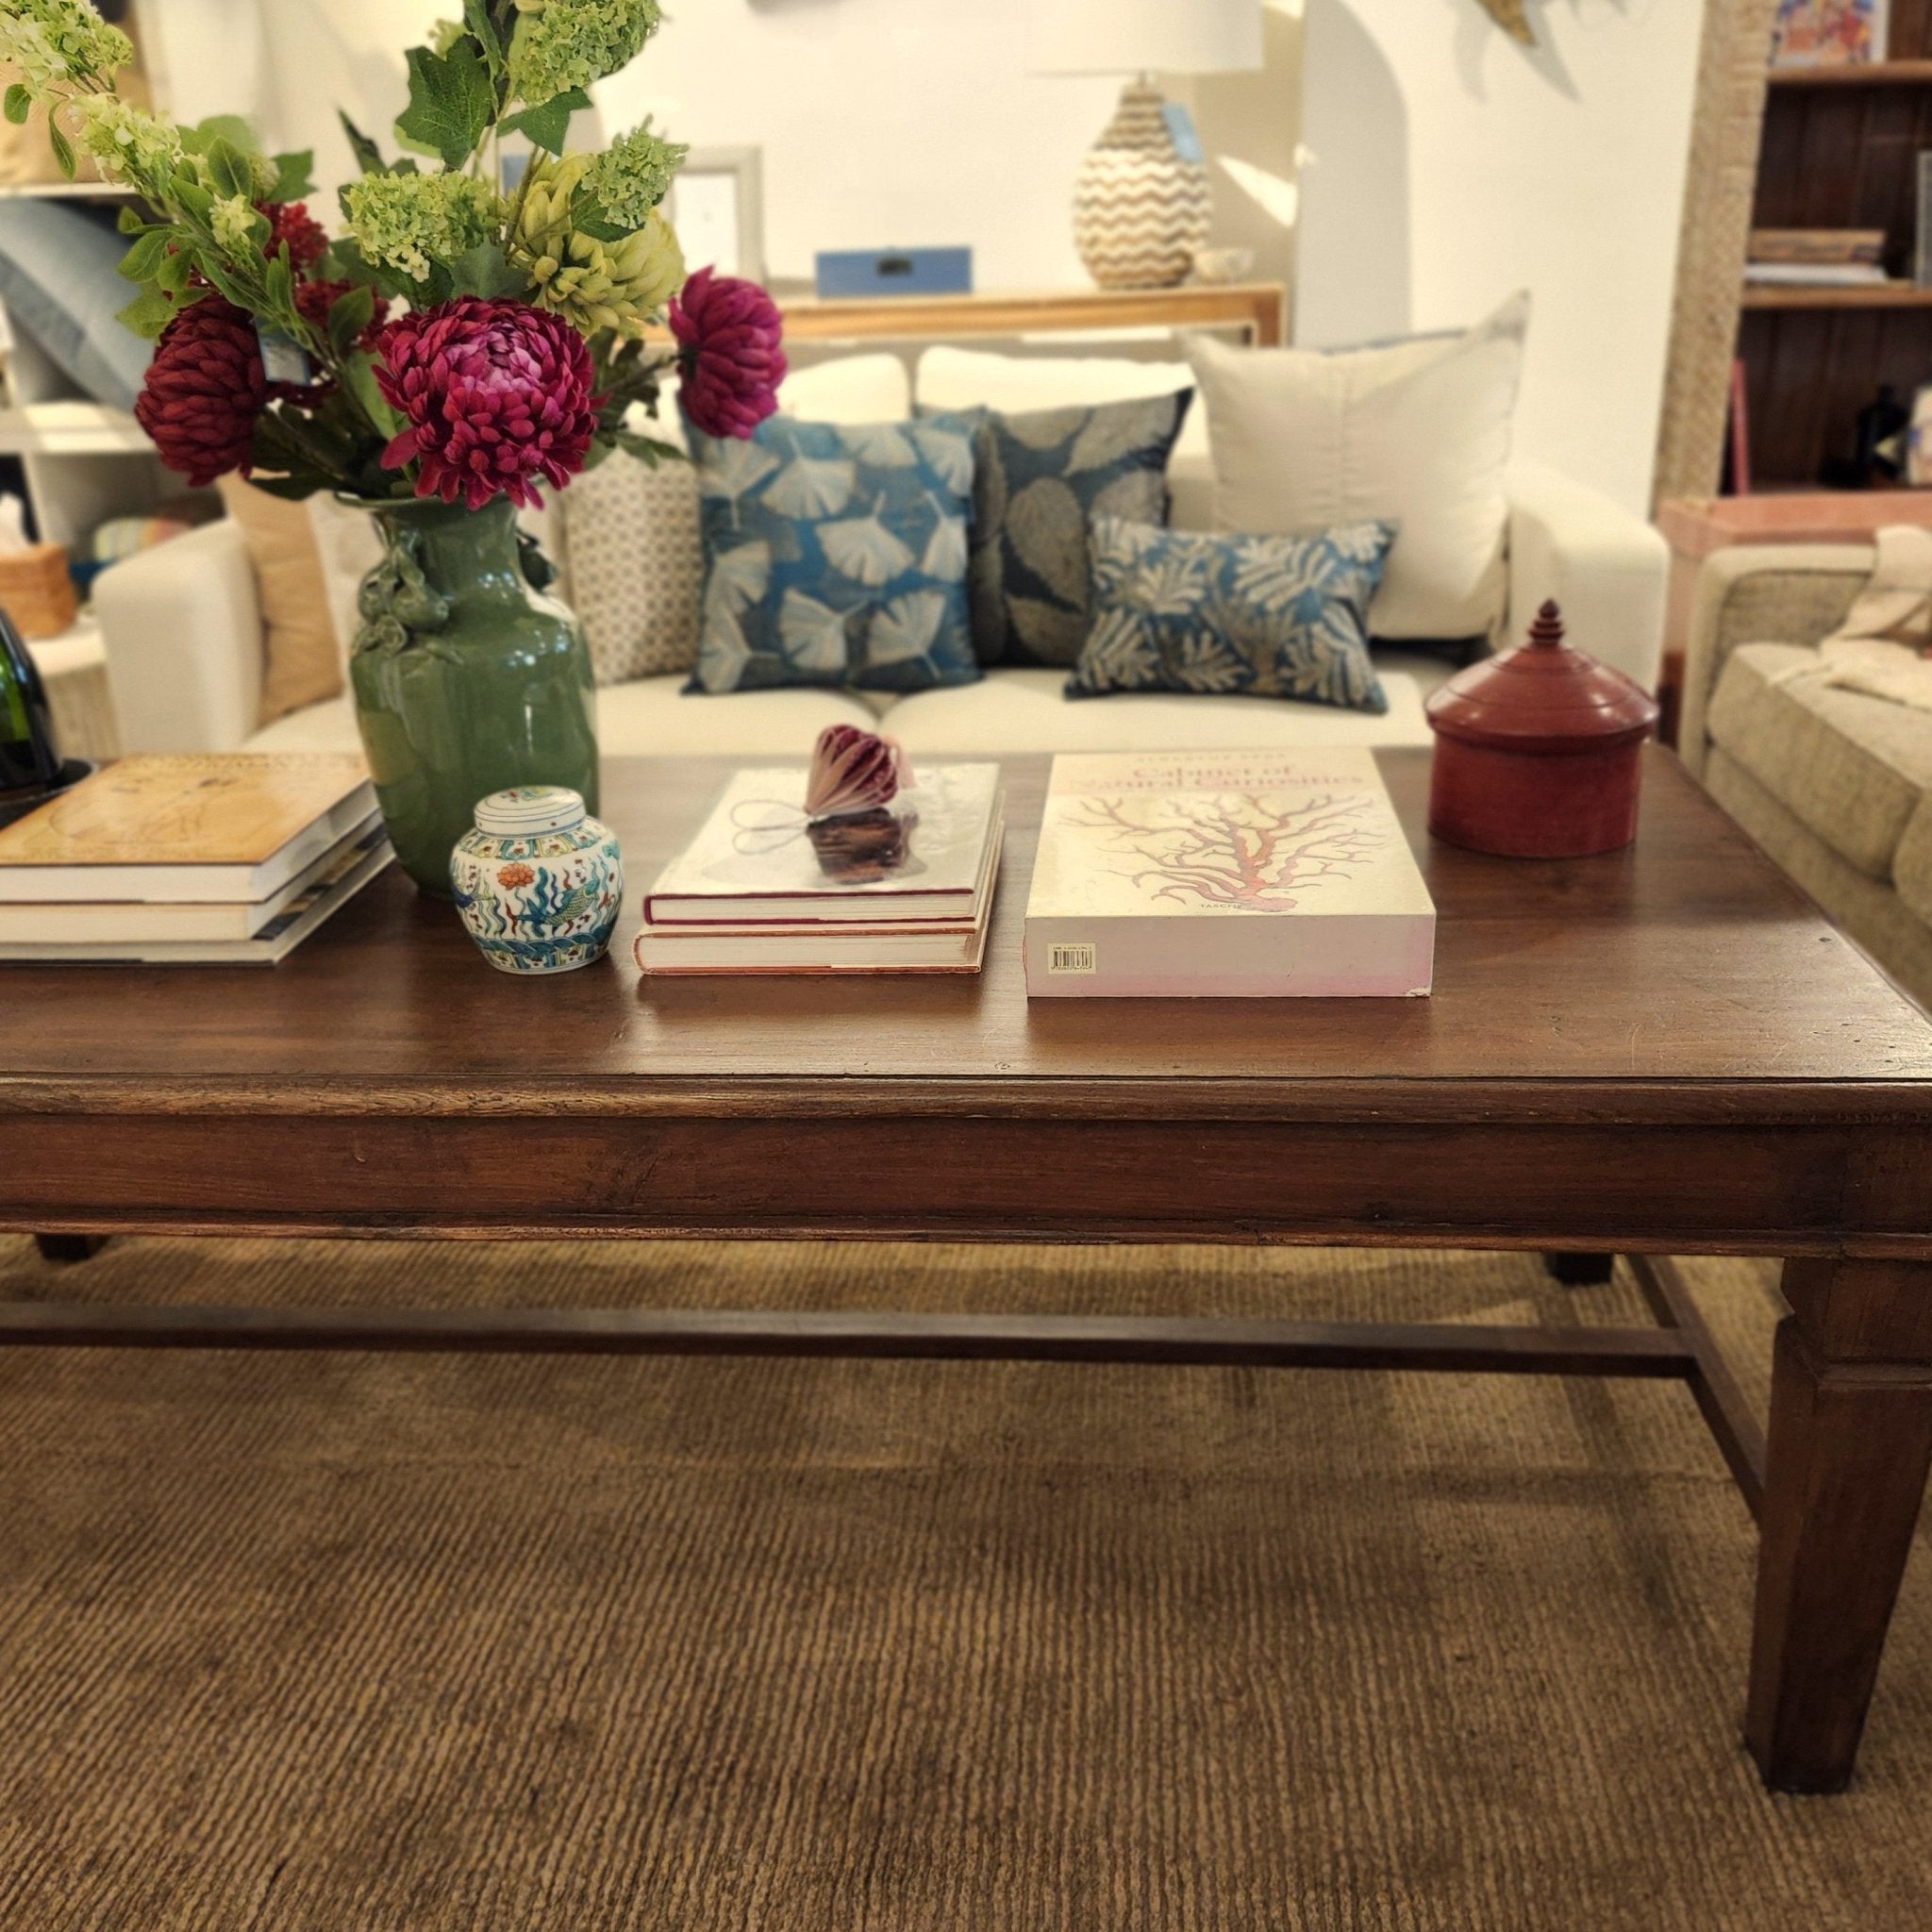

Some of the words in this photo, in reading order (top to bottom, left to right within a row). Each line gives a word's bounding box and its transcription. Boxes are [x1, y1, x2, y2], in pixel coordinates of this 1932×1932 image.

[1133, 766, 1251, 778] Cabinet
[1262, 764, 1296, 775] of
[1193, 774, 1363, 789] Curiosities
